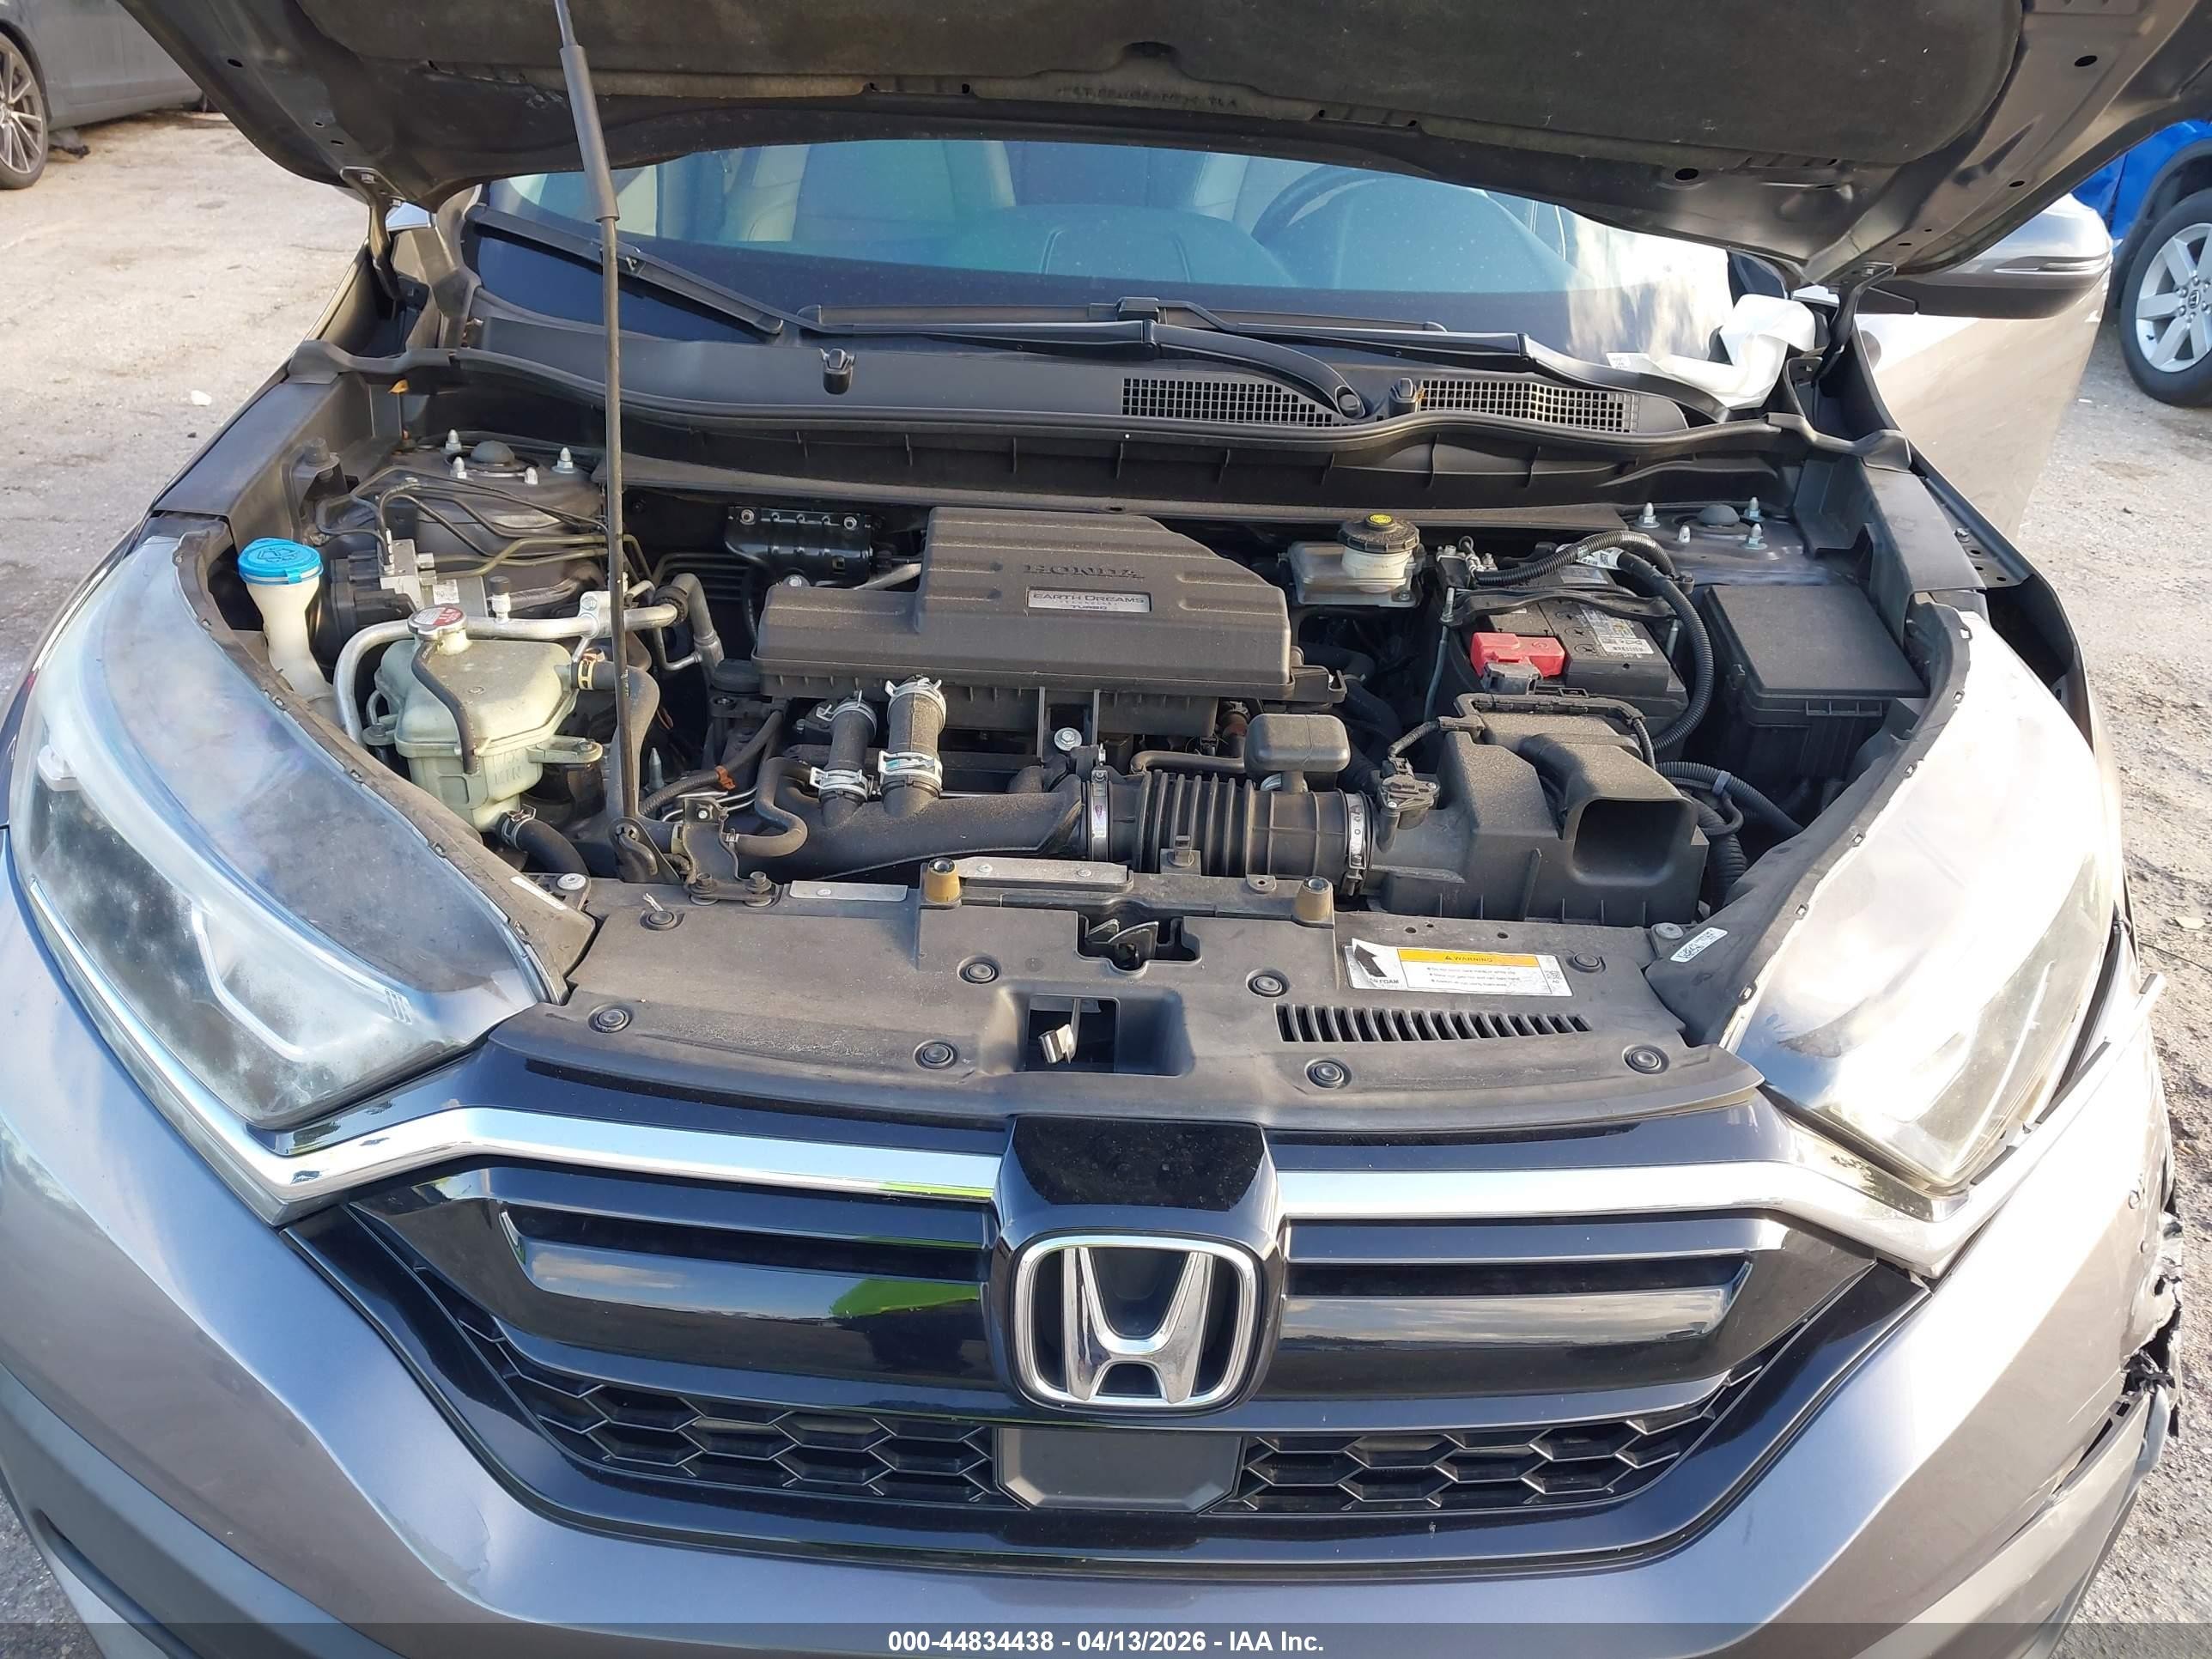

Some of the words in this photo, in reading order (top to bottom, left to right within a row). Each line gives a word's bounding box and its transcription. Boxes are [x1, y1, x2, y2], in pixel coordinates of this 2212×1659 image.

[1023, 563, 1146, 580] HONDA
[1033, 592, 1082, 601] EARTH
[1085, 595, 1145, 604] DREAMS
